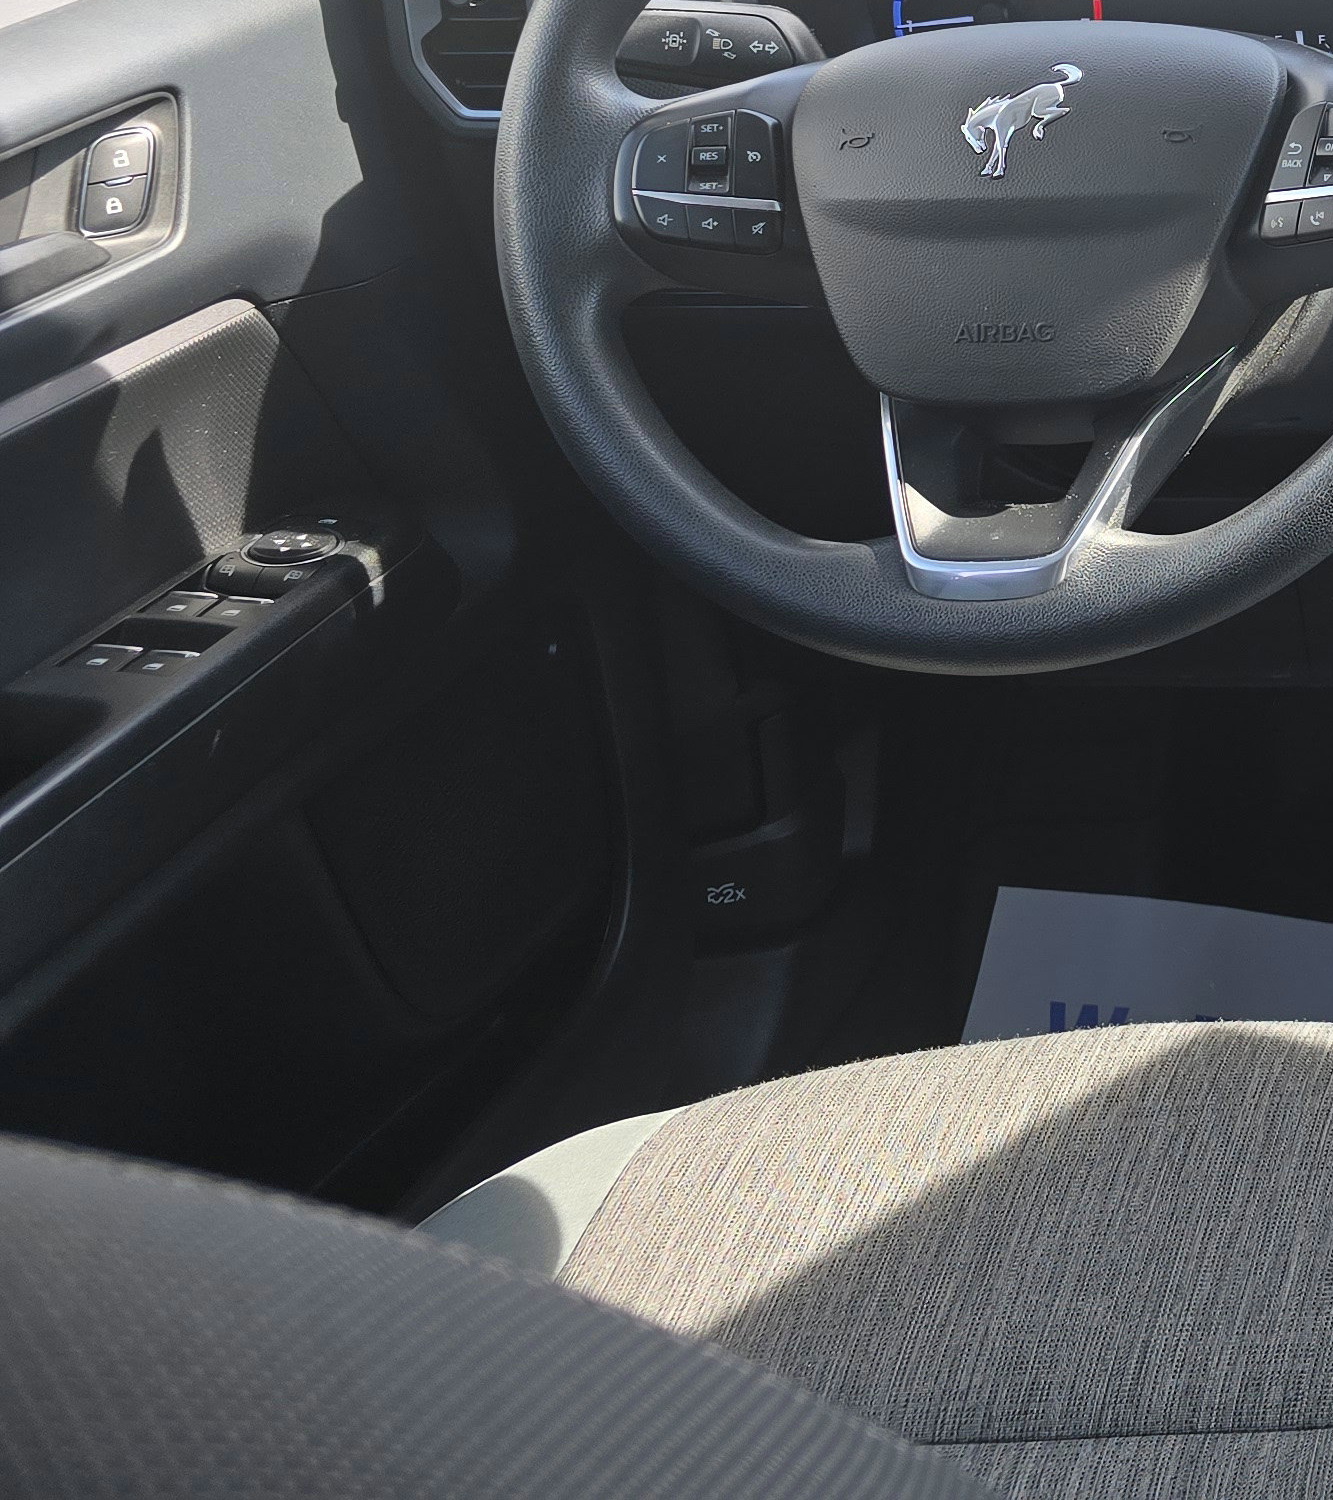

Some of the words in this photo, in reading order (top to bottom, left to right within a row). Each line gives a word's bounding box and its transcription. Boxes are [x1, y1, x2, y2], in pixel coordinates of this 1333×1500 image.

[700, 123, 724, 133] SET+
[699, 151, 719, 161] RES
[1281, 159, 1303, 168] BACK
[954, 322, 1056, 344] AIRBAG
